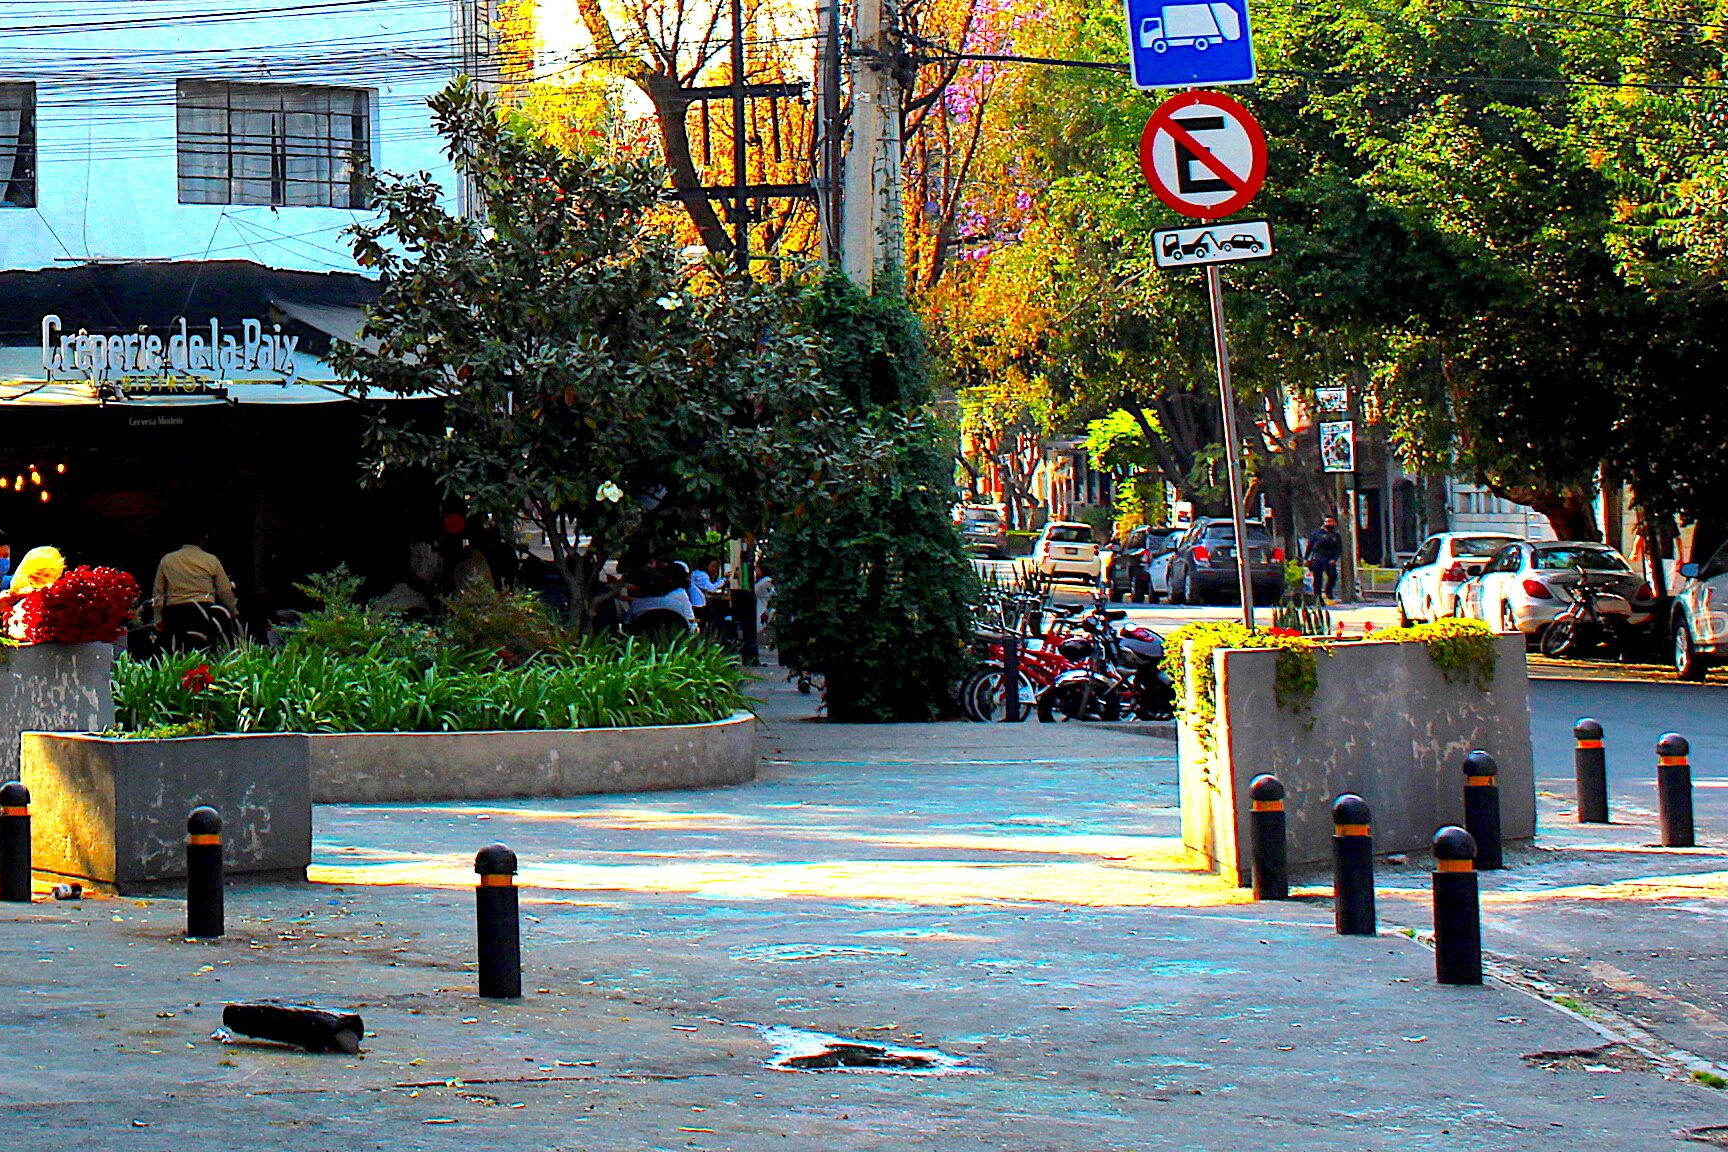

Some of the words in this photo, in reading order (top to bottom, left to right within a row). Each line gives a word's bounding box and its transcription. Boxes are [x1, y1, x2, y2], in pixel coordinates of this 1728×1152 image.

[169, 317, 204, 370] de
[210, 317, 237, 371] la
[242, 318, 299, 388] Paix
[122, 376, 209, 393] BISTROT
